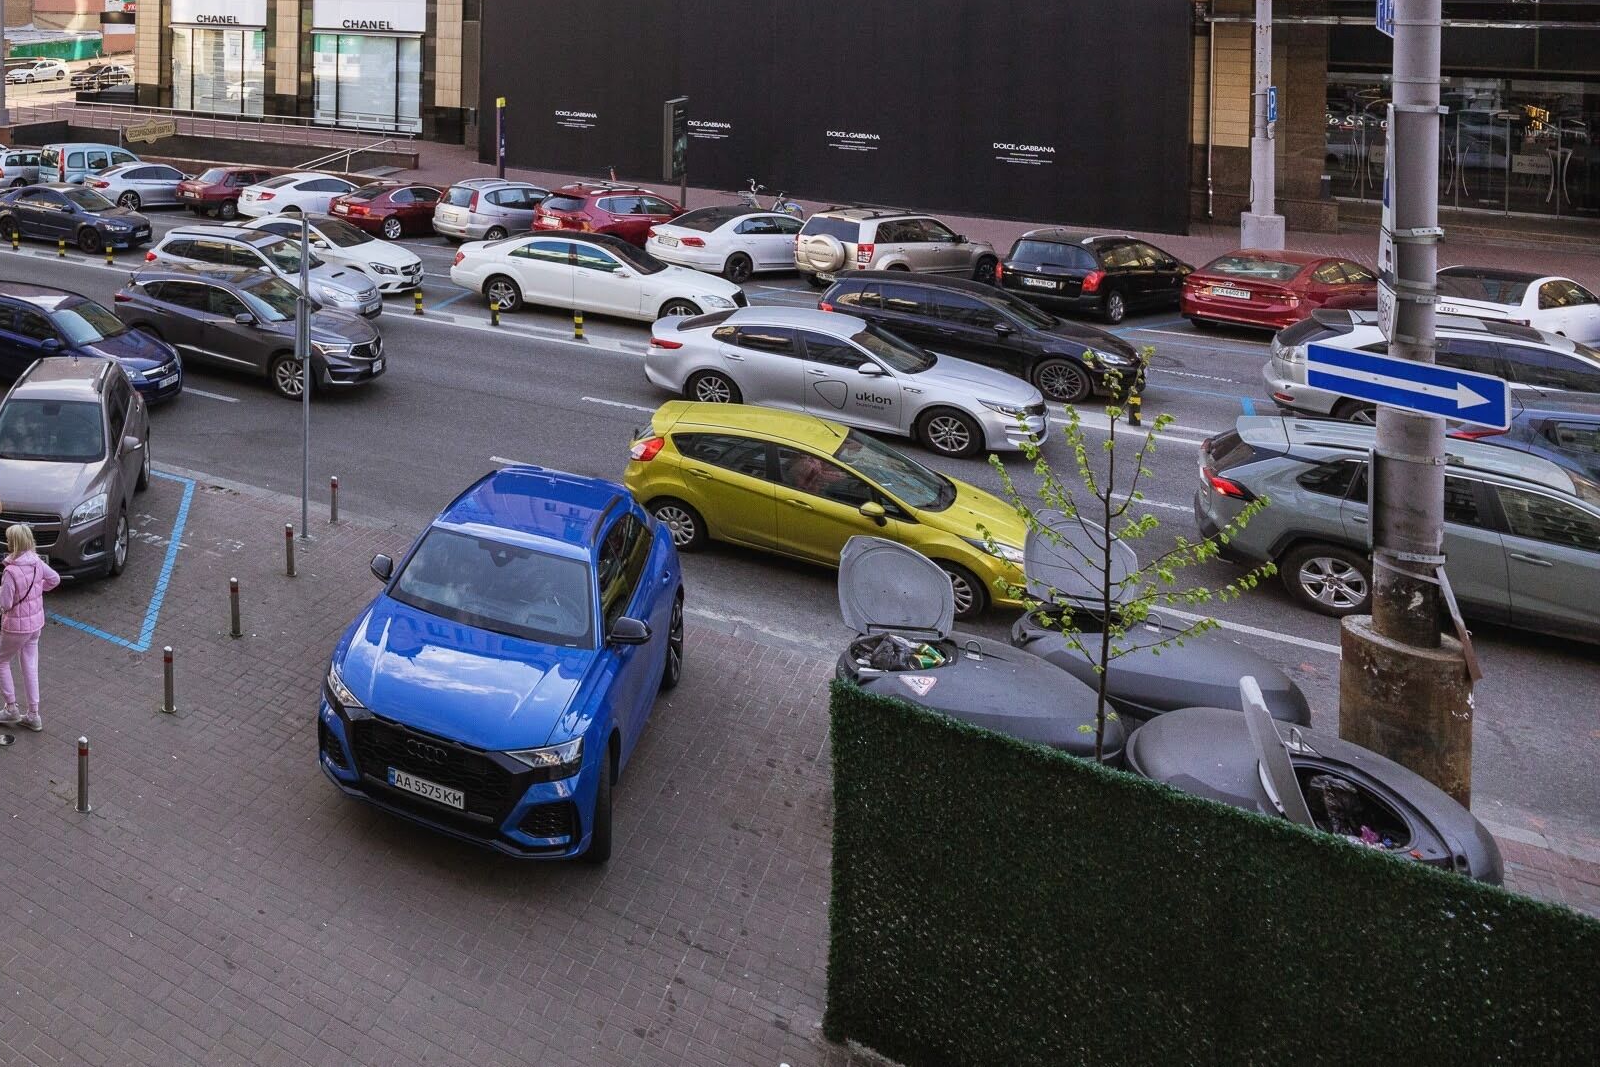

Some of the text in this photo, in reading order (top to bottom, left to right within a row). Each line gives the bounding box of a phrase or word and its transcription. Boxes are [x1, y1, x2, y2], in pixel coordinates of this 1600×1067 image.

[196, 15, 239, 24] CHANEL
[342, 19, 393, 30] CHANEL
[1270, 91, 1276, 118] P
[1019, 145, 1055, 153] GABBANA
[856, 392, 892, 405] uklon
[396, 774, 462, 806] AA 5575 KM
